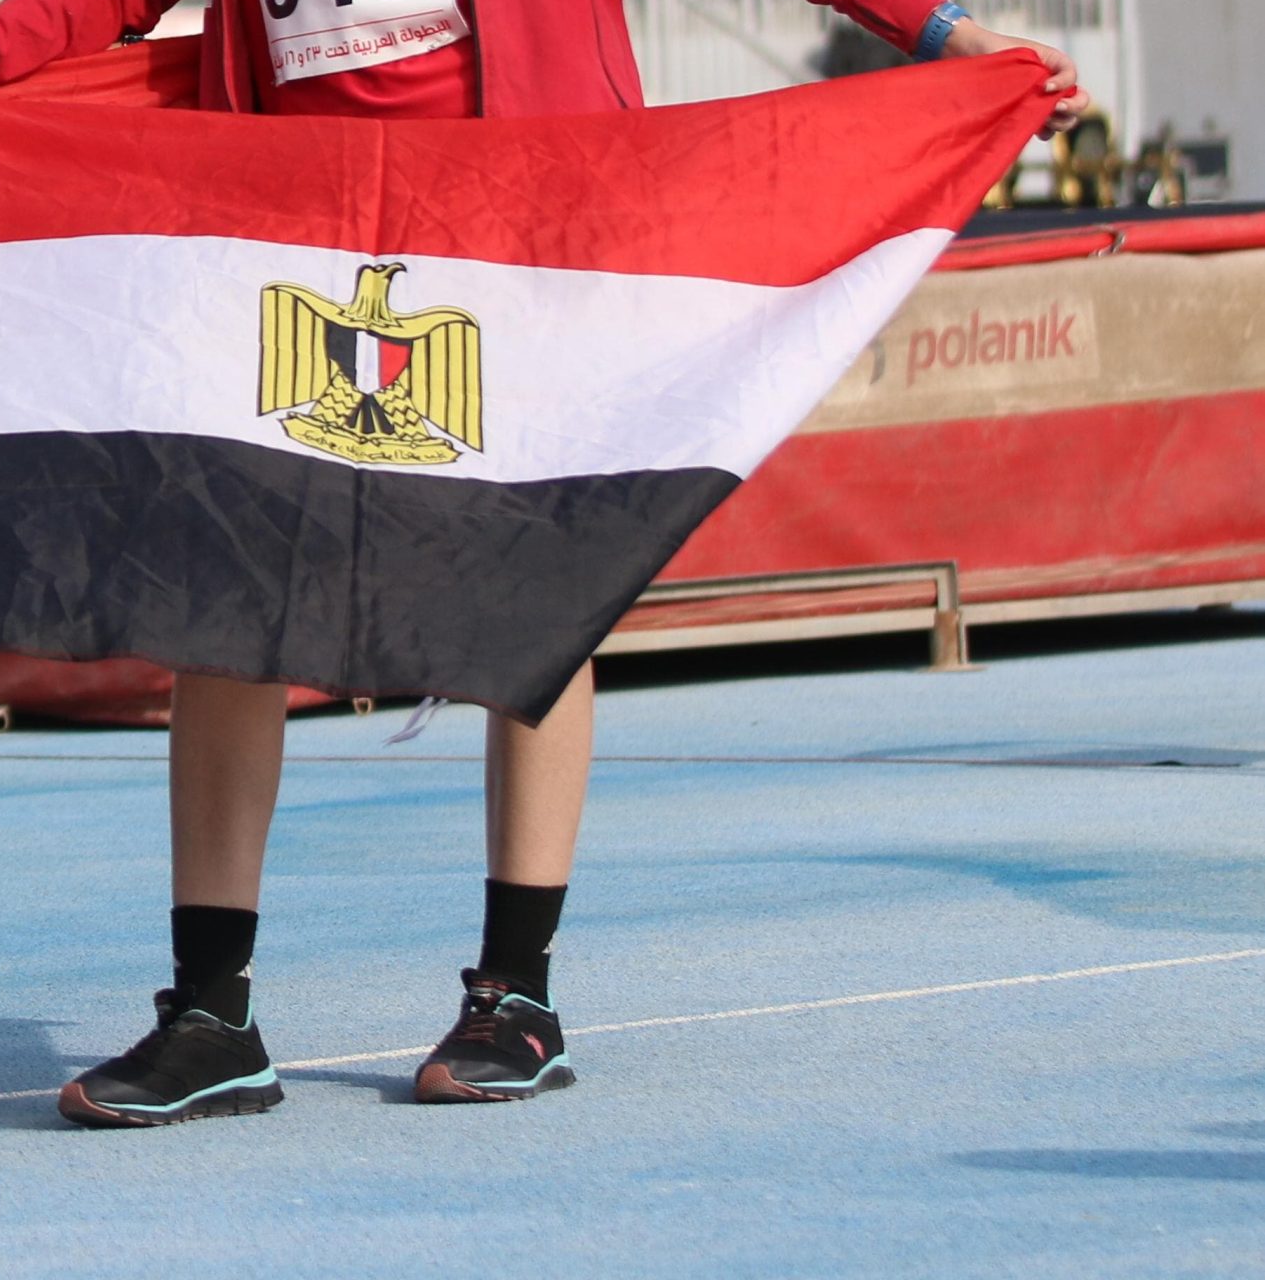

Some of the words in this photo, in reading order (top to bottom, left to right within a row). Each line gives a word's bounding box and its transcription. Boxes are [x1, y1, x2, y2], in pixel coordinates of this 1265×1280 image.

[402, 19, 451, 43] البطولة
[325, 41, 350, 59] تحت
[353, 32, 397, 55] العربية
